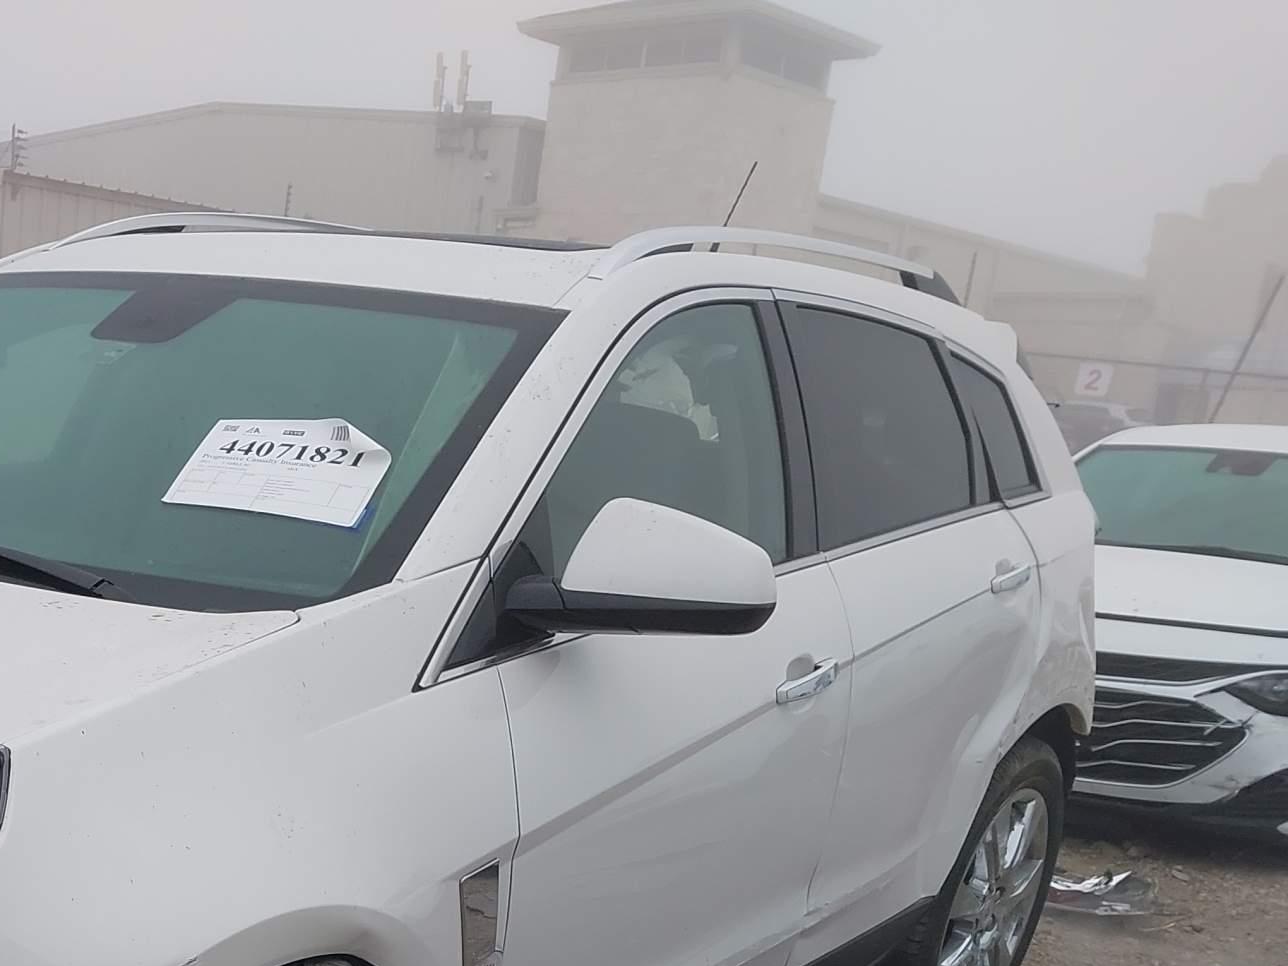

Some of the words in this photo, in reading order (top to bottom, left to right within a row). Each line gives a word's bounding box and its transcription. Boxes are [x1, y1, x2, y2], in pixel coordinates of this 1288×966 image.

[1083, 369, 1102, 391] 2
[219, 439, 366, 467] 44071821
[280, 459, 317, 468] Insurance
